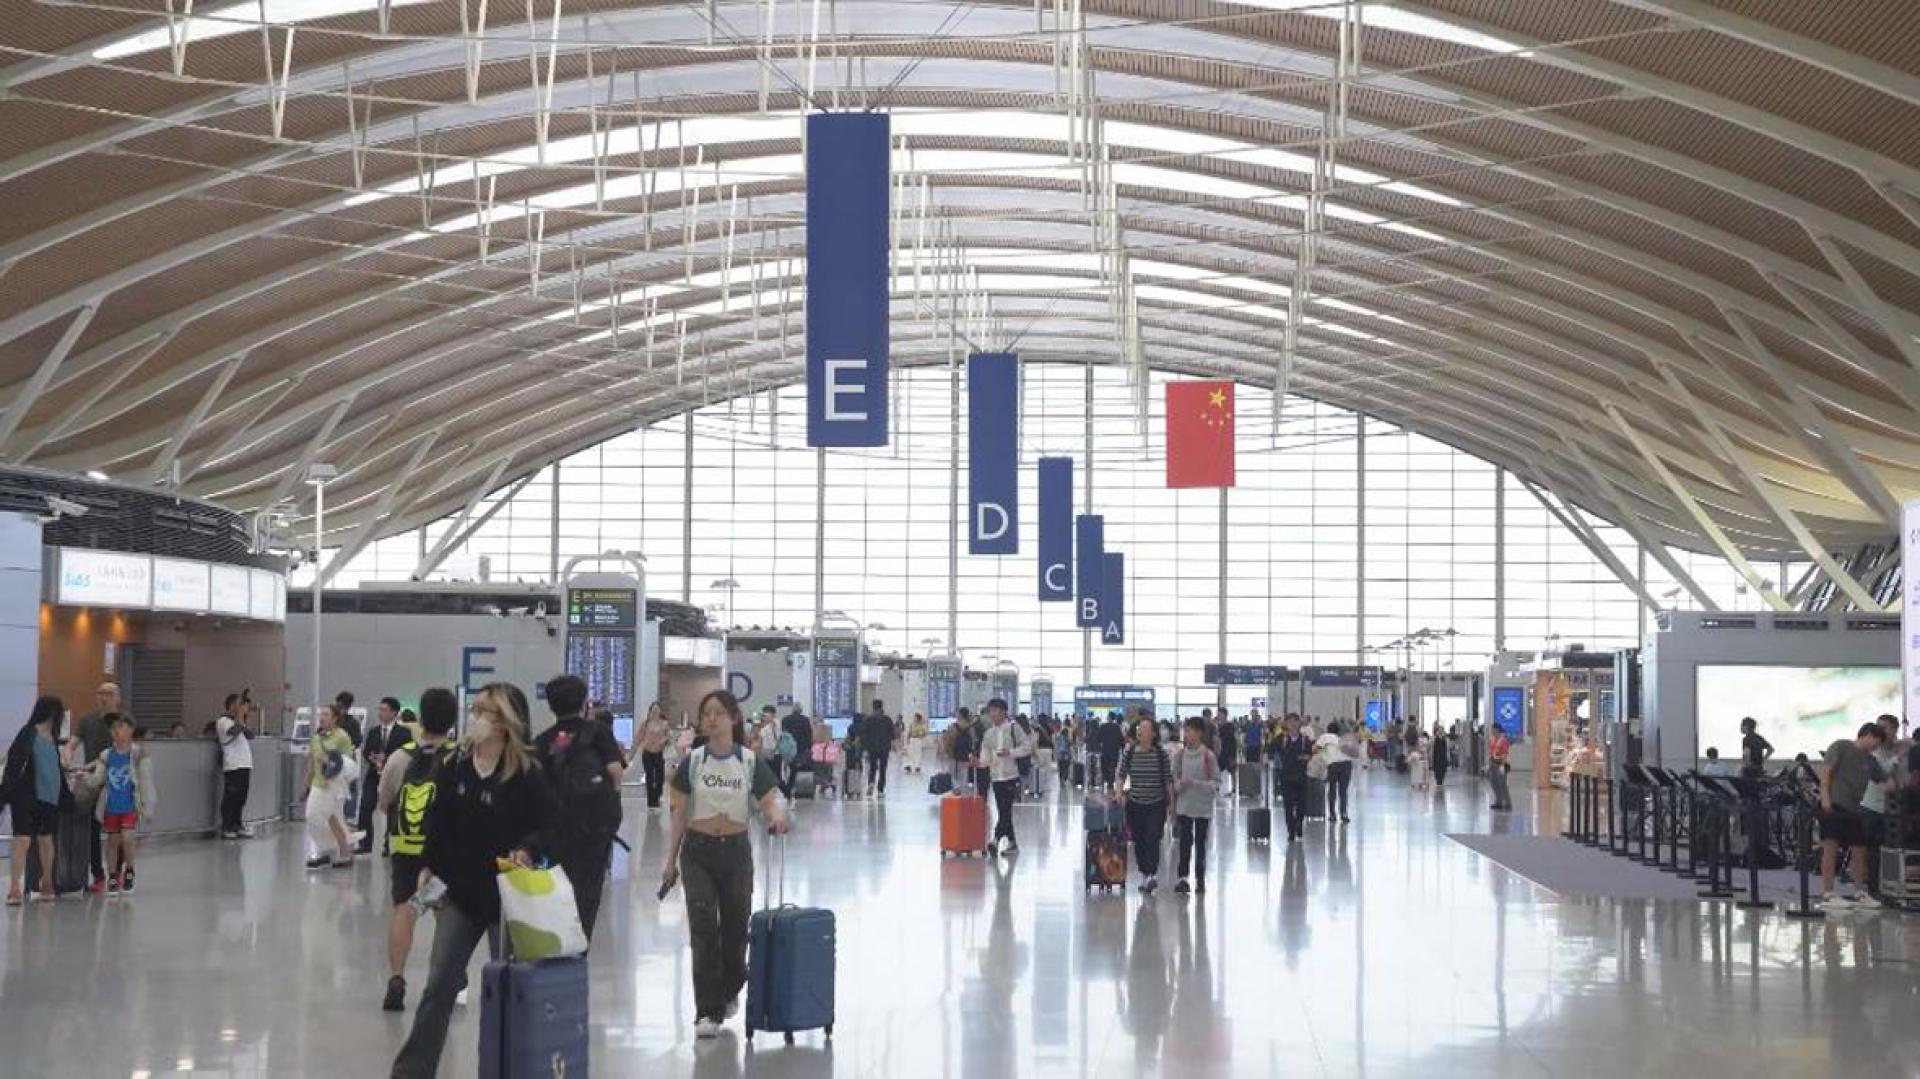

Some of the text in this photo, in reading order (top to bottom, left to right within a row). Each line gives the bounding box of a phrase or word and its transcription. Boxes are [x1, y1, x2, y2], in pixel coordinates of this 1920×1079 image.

[824, 359, 868, 421] E
[977, 502, 1009, 541] D
[1045, 563, 1066, 591] C
[1082, 597, 1098, 620] B
[1105, 620, 1121, 639] A
[463, 646, 497, 695] E
[727, 671, 753, 703] D
